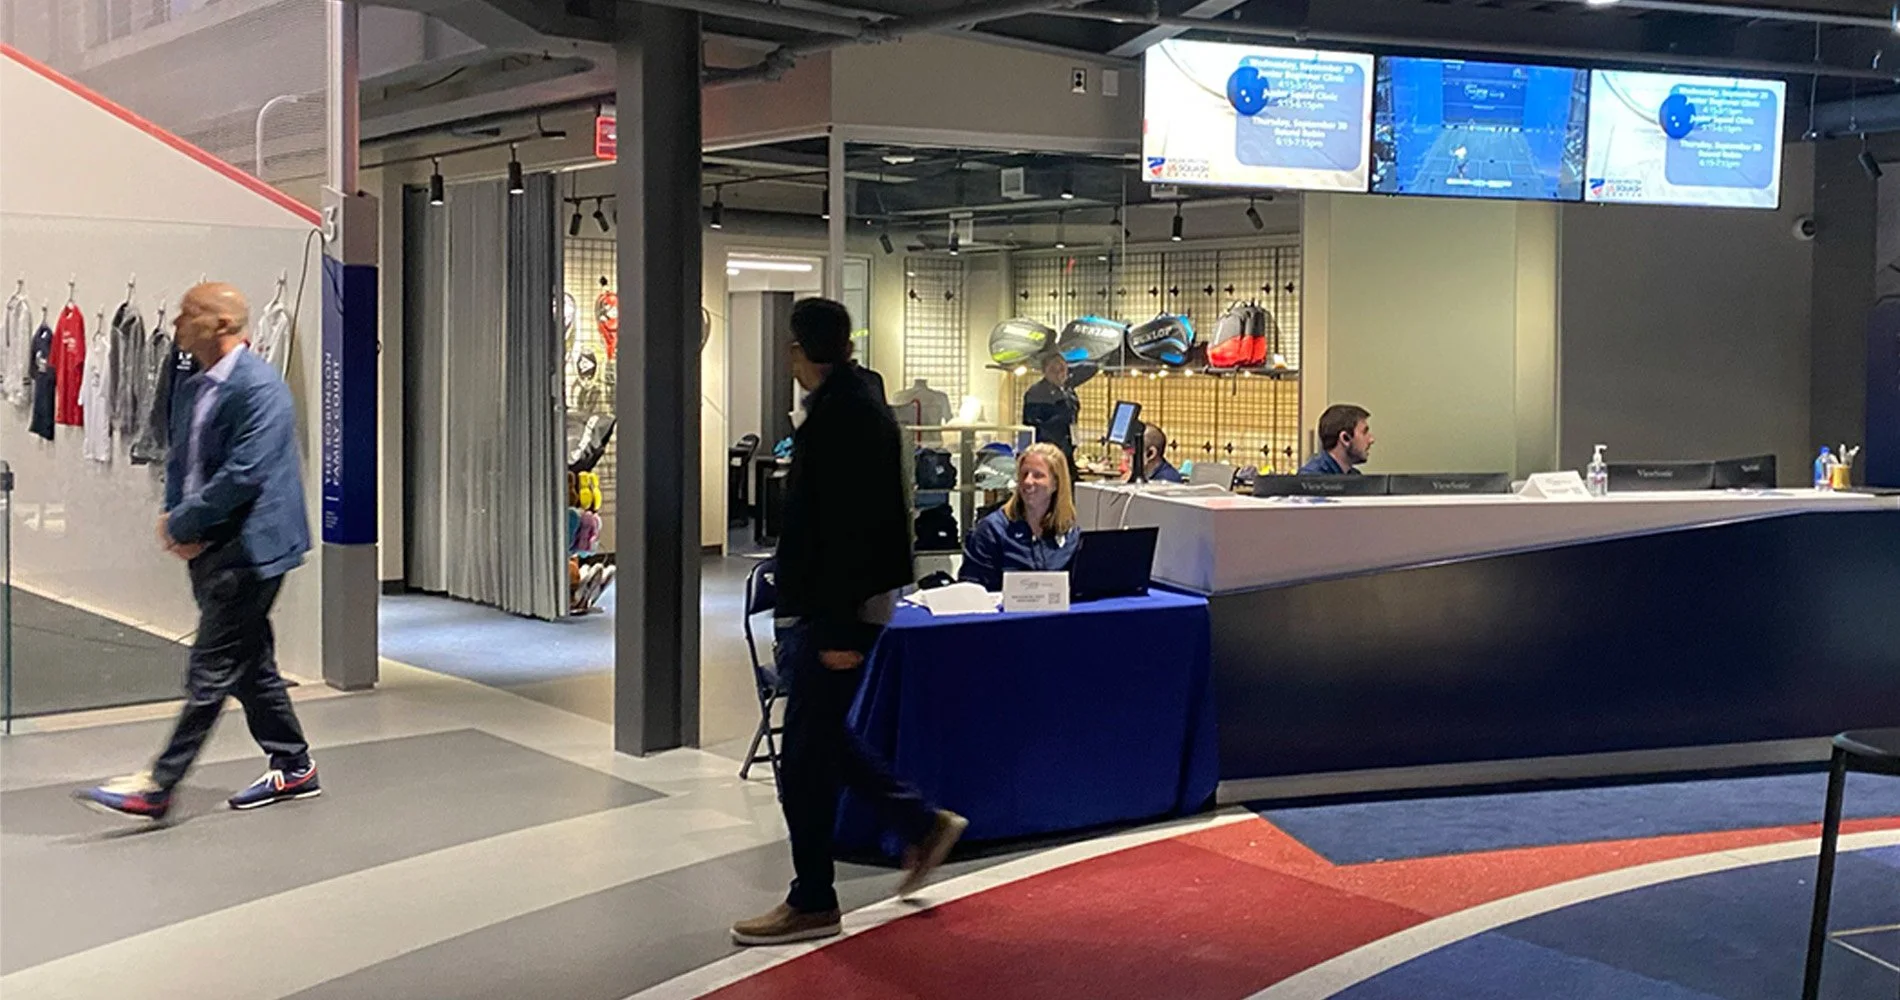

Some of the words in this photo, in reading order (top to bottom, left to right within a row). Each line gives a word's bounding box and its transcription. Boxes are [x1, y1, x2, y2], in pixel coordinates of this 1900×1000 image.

[323, 204, 339, 243] 3
[324, 352, 332, 446] ROBINSON
[333, 362, 341, 420] COURT
[324, 452, 332, 485] THE
[333, 424, 341, 487] FAMILY
[1301, 481, 1345, 492] ViewSonic
